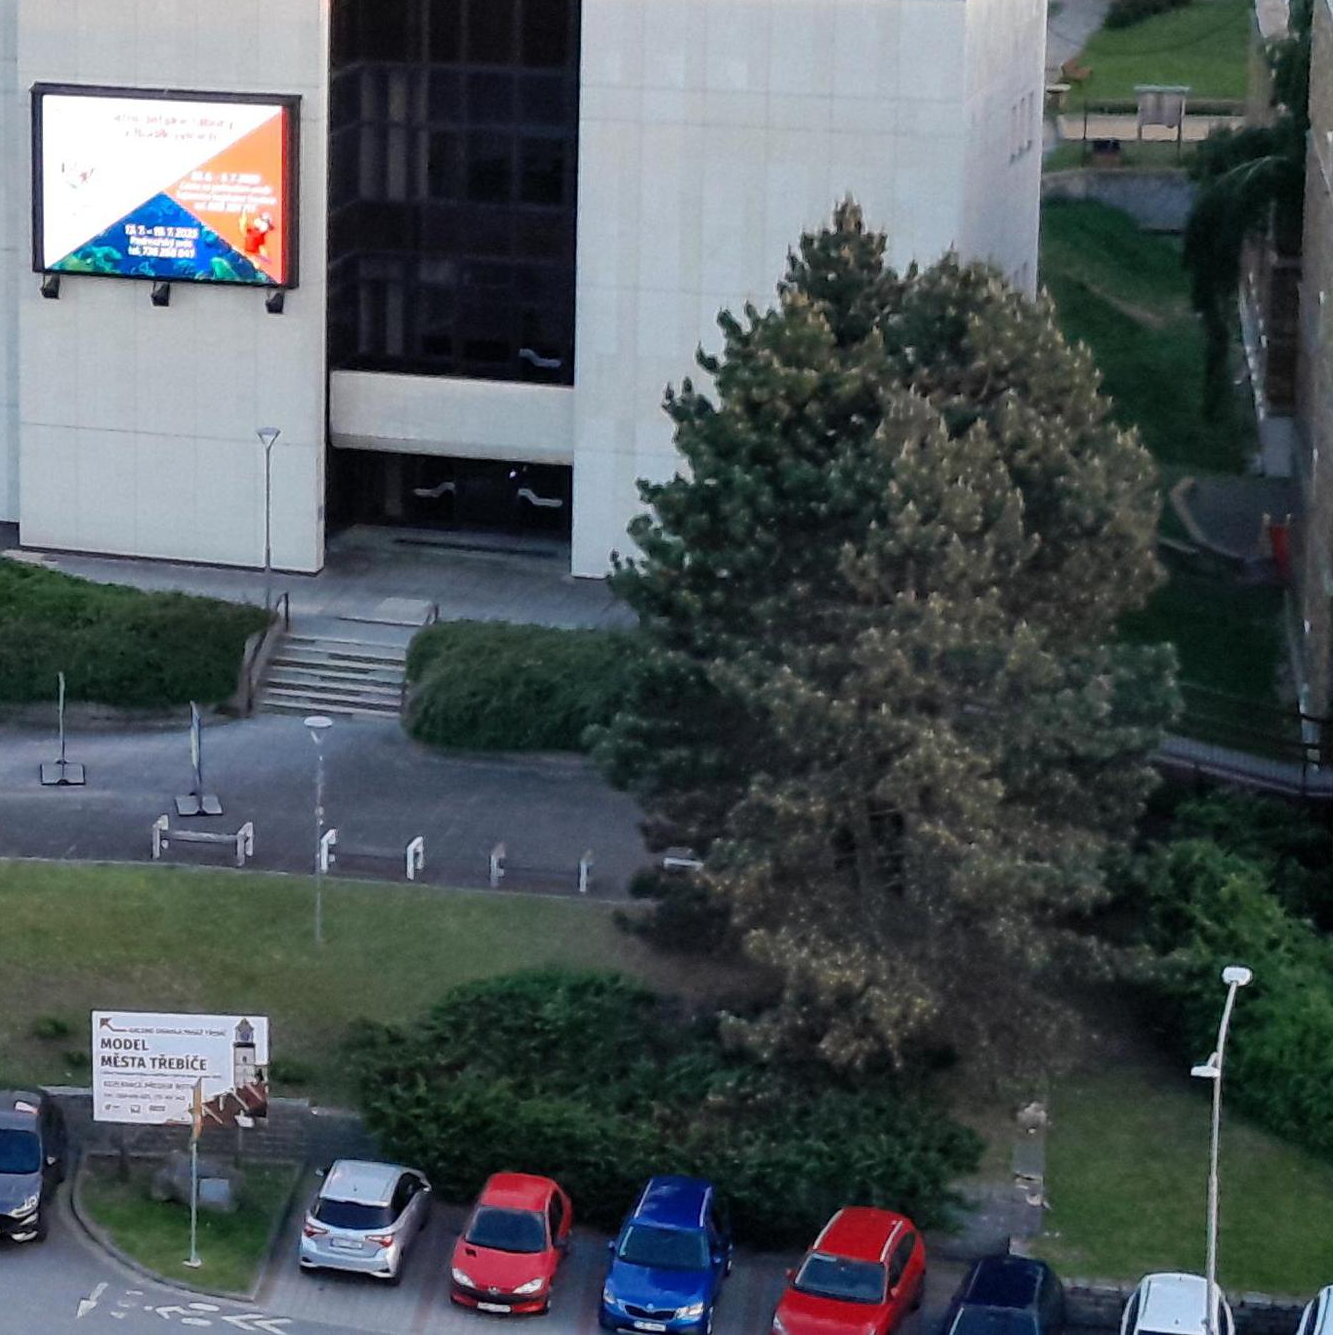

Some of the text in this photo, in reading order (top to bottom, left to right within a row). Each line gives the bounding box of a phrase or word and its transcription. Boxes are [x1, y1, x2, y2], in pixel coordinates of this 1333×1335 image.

[100, 1038, 149, 1051] MODEL
[101, 1053, 207, 1070] MĚSTA TŘEBÍČE
